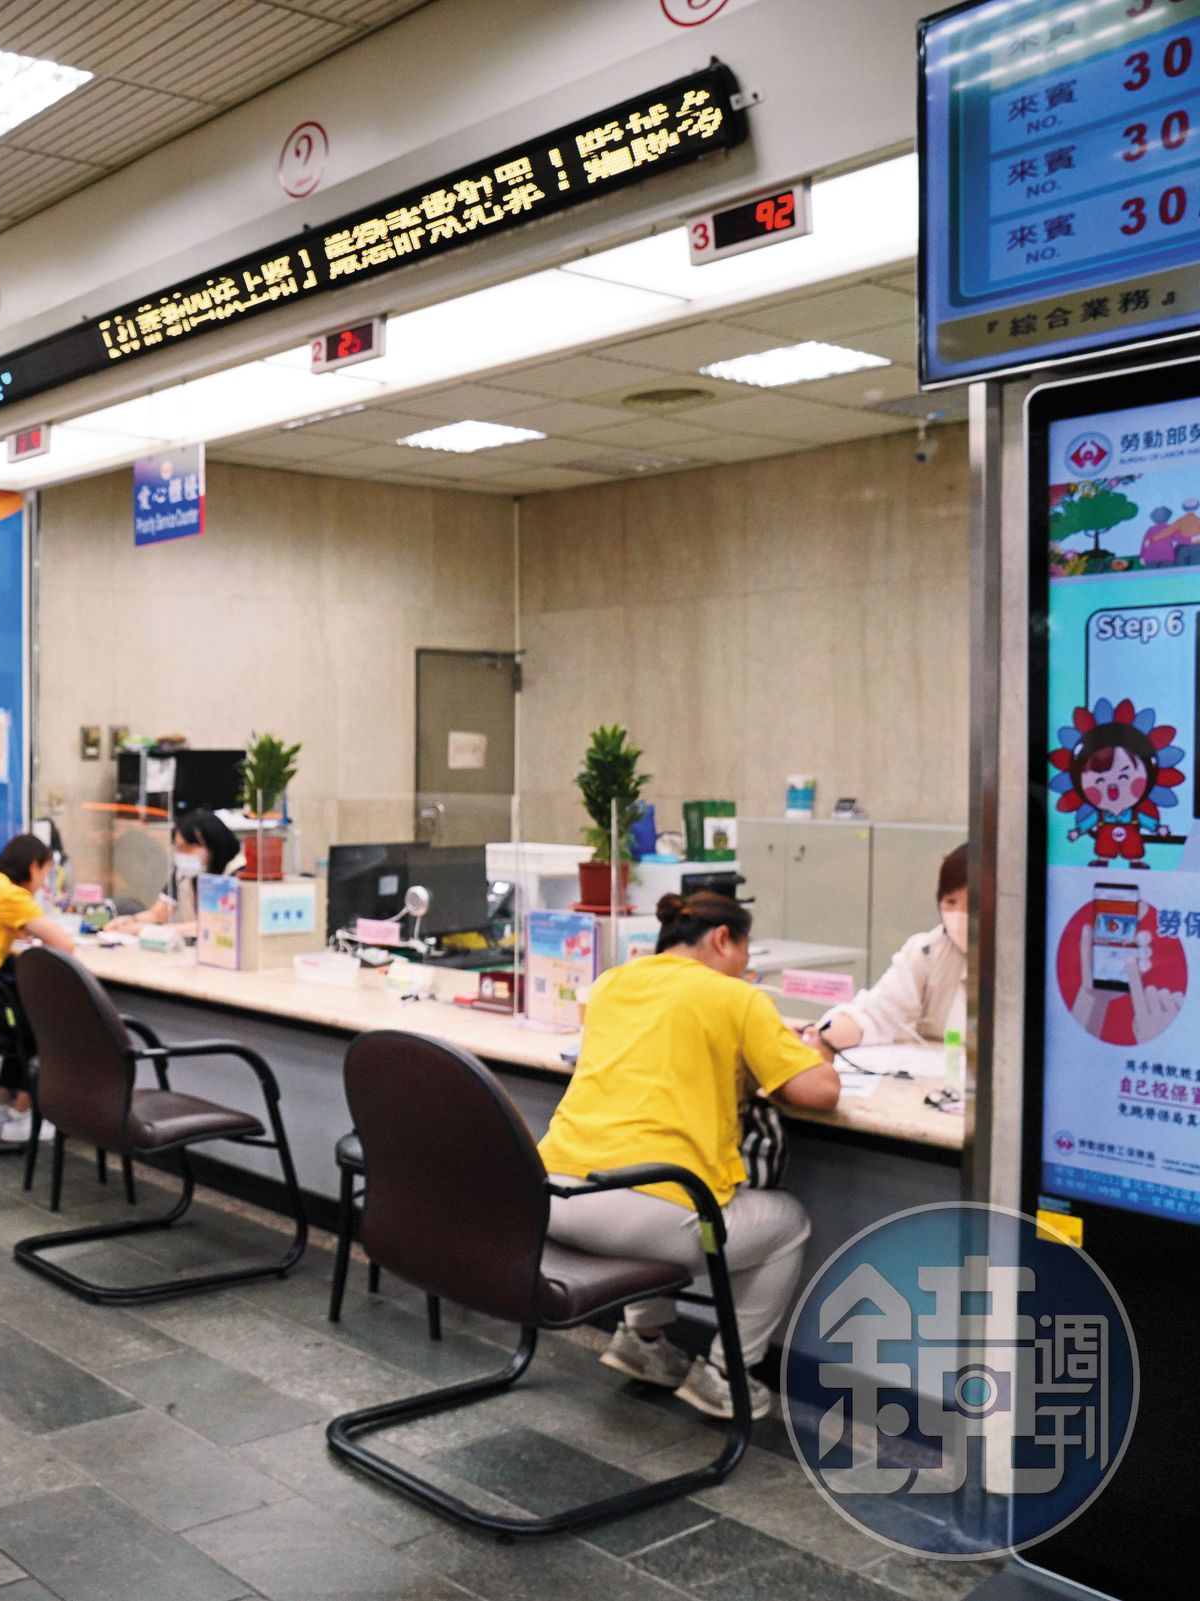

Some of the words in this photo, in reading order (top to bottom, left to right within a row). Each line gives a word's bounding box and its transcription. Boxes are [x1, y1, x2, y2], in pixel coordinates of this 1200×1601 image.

[1026, 115, 1063, 135] NO.
[1026, 180, 1062, 199] NO.
[755, 193, 794, 231] 92
[692, 222, 710, 250] 3
[1025, 247, 1061, 265] NO.
[987, 287, 1175, 338] 『綜合業務』
[312, 340, 323, 363] 2
[1096, 614, 1160, 644] Step
[1165, 609, 1184, 637] 6
[1160, 910, 1200, 938] 勞保
